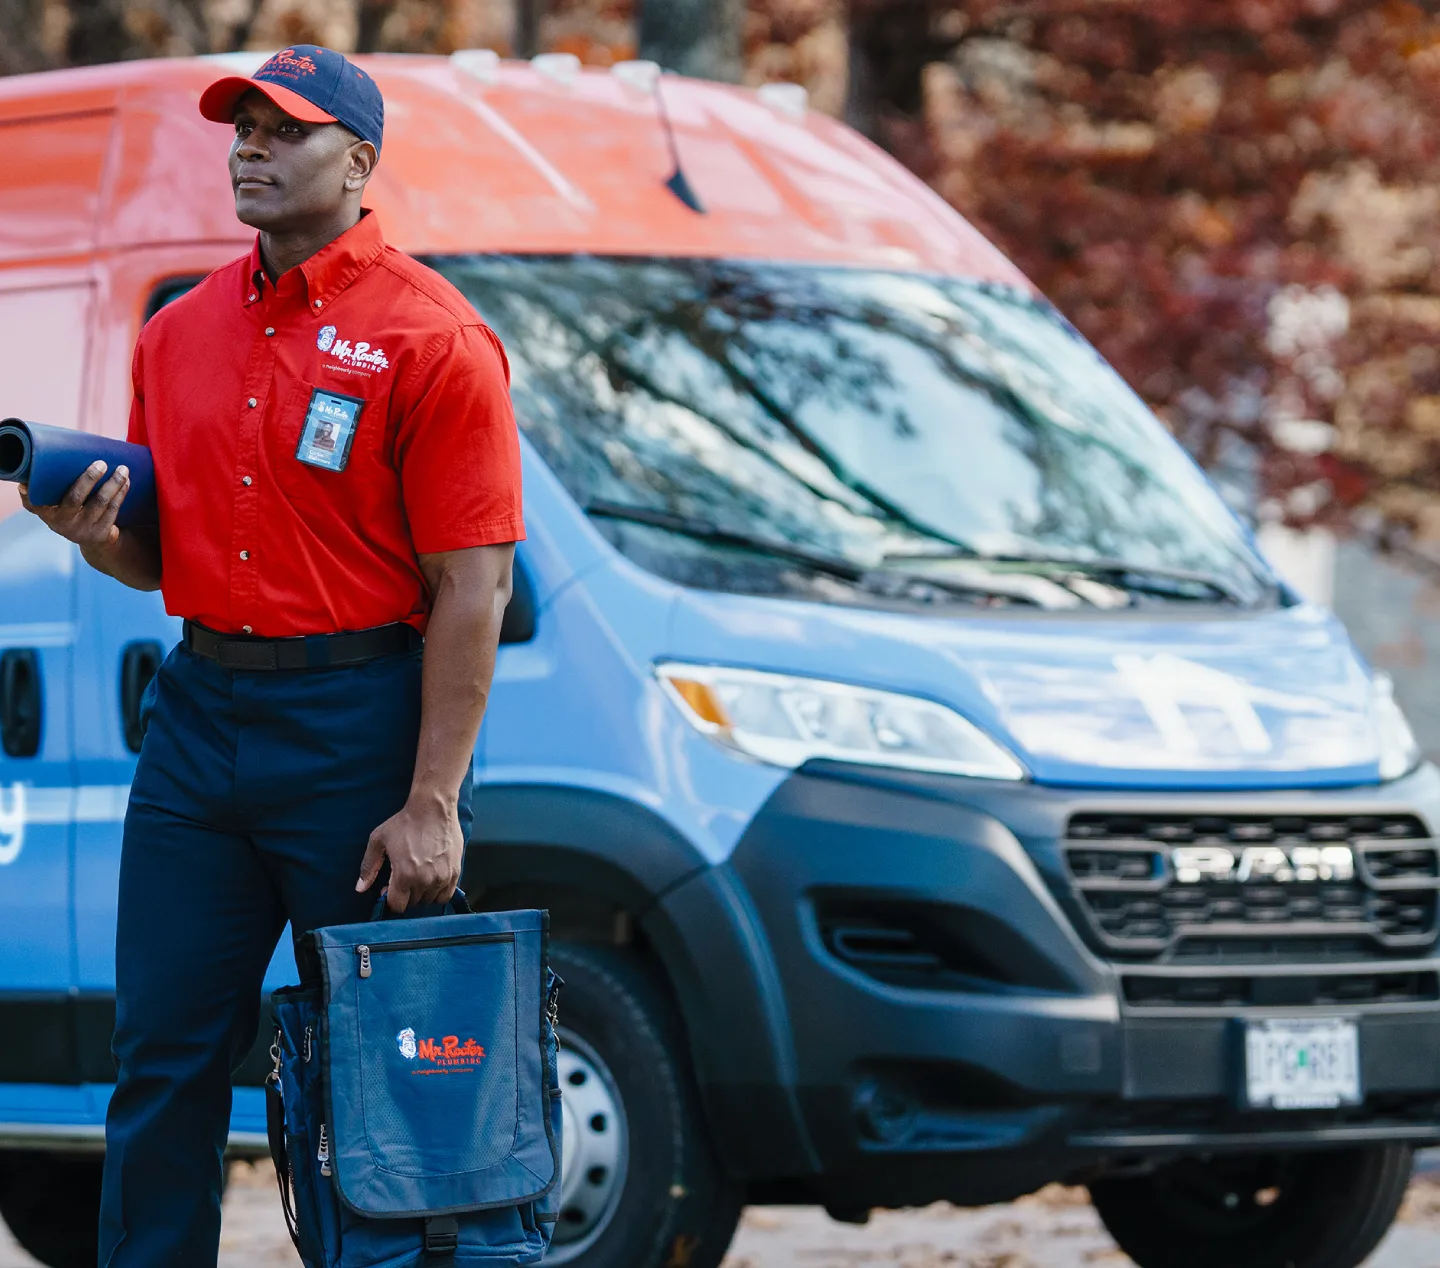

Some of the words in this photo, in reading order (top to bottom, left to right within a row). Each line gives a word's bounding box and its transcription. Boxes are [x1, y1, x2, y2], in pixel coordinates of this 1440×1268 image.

[330, 339, 353, 360] Mr.
[352, 341, 389, 368] Rooter
[342, 358, 382, 373] PLUMBING
[1171, 846, 1354, 884] RAM
[418, 1038, 444, 1062] Mr.
[442, 1035, 485, 1059] Rooter
[437, 1057, 481, 1067] PLUMBING
